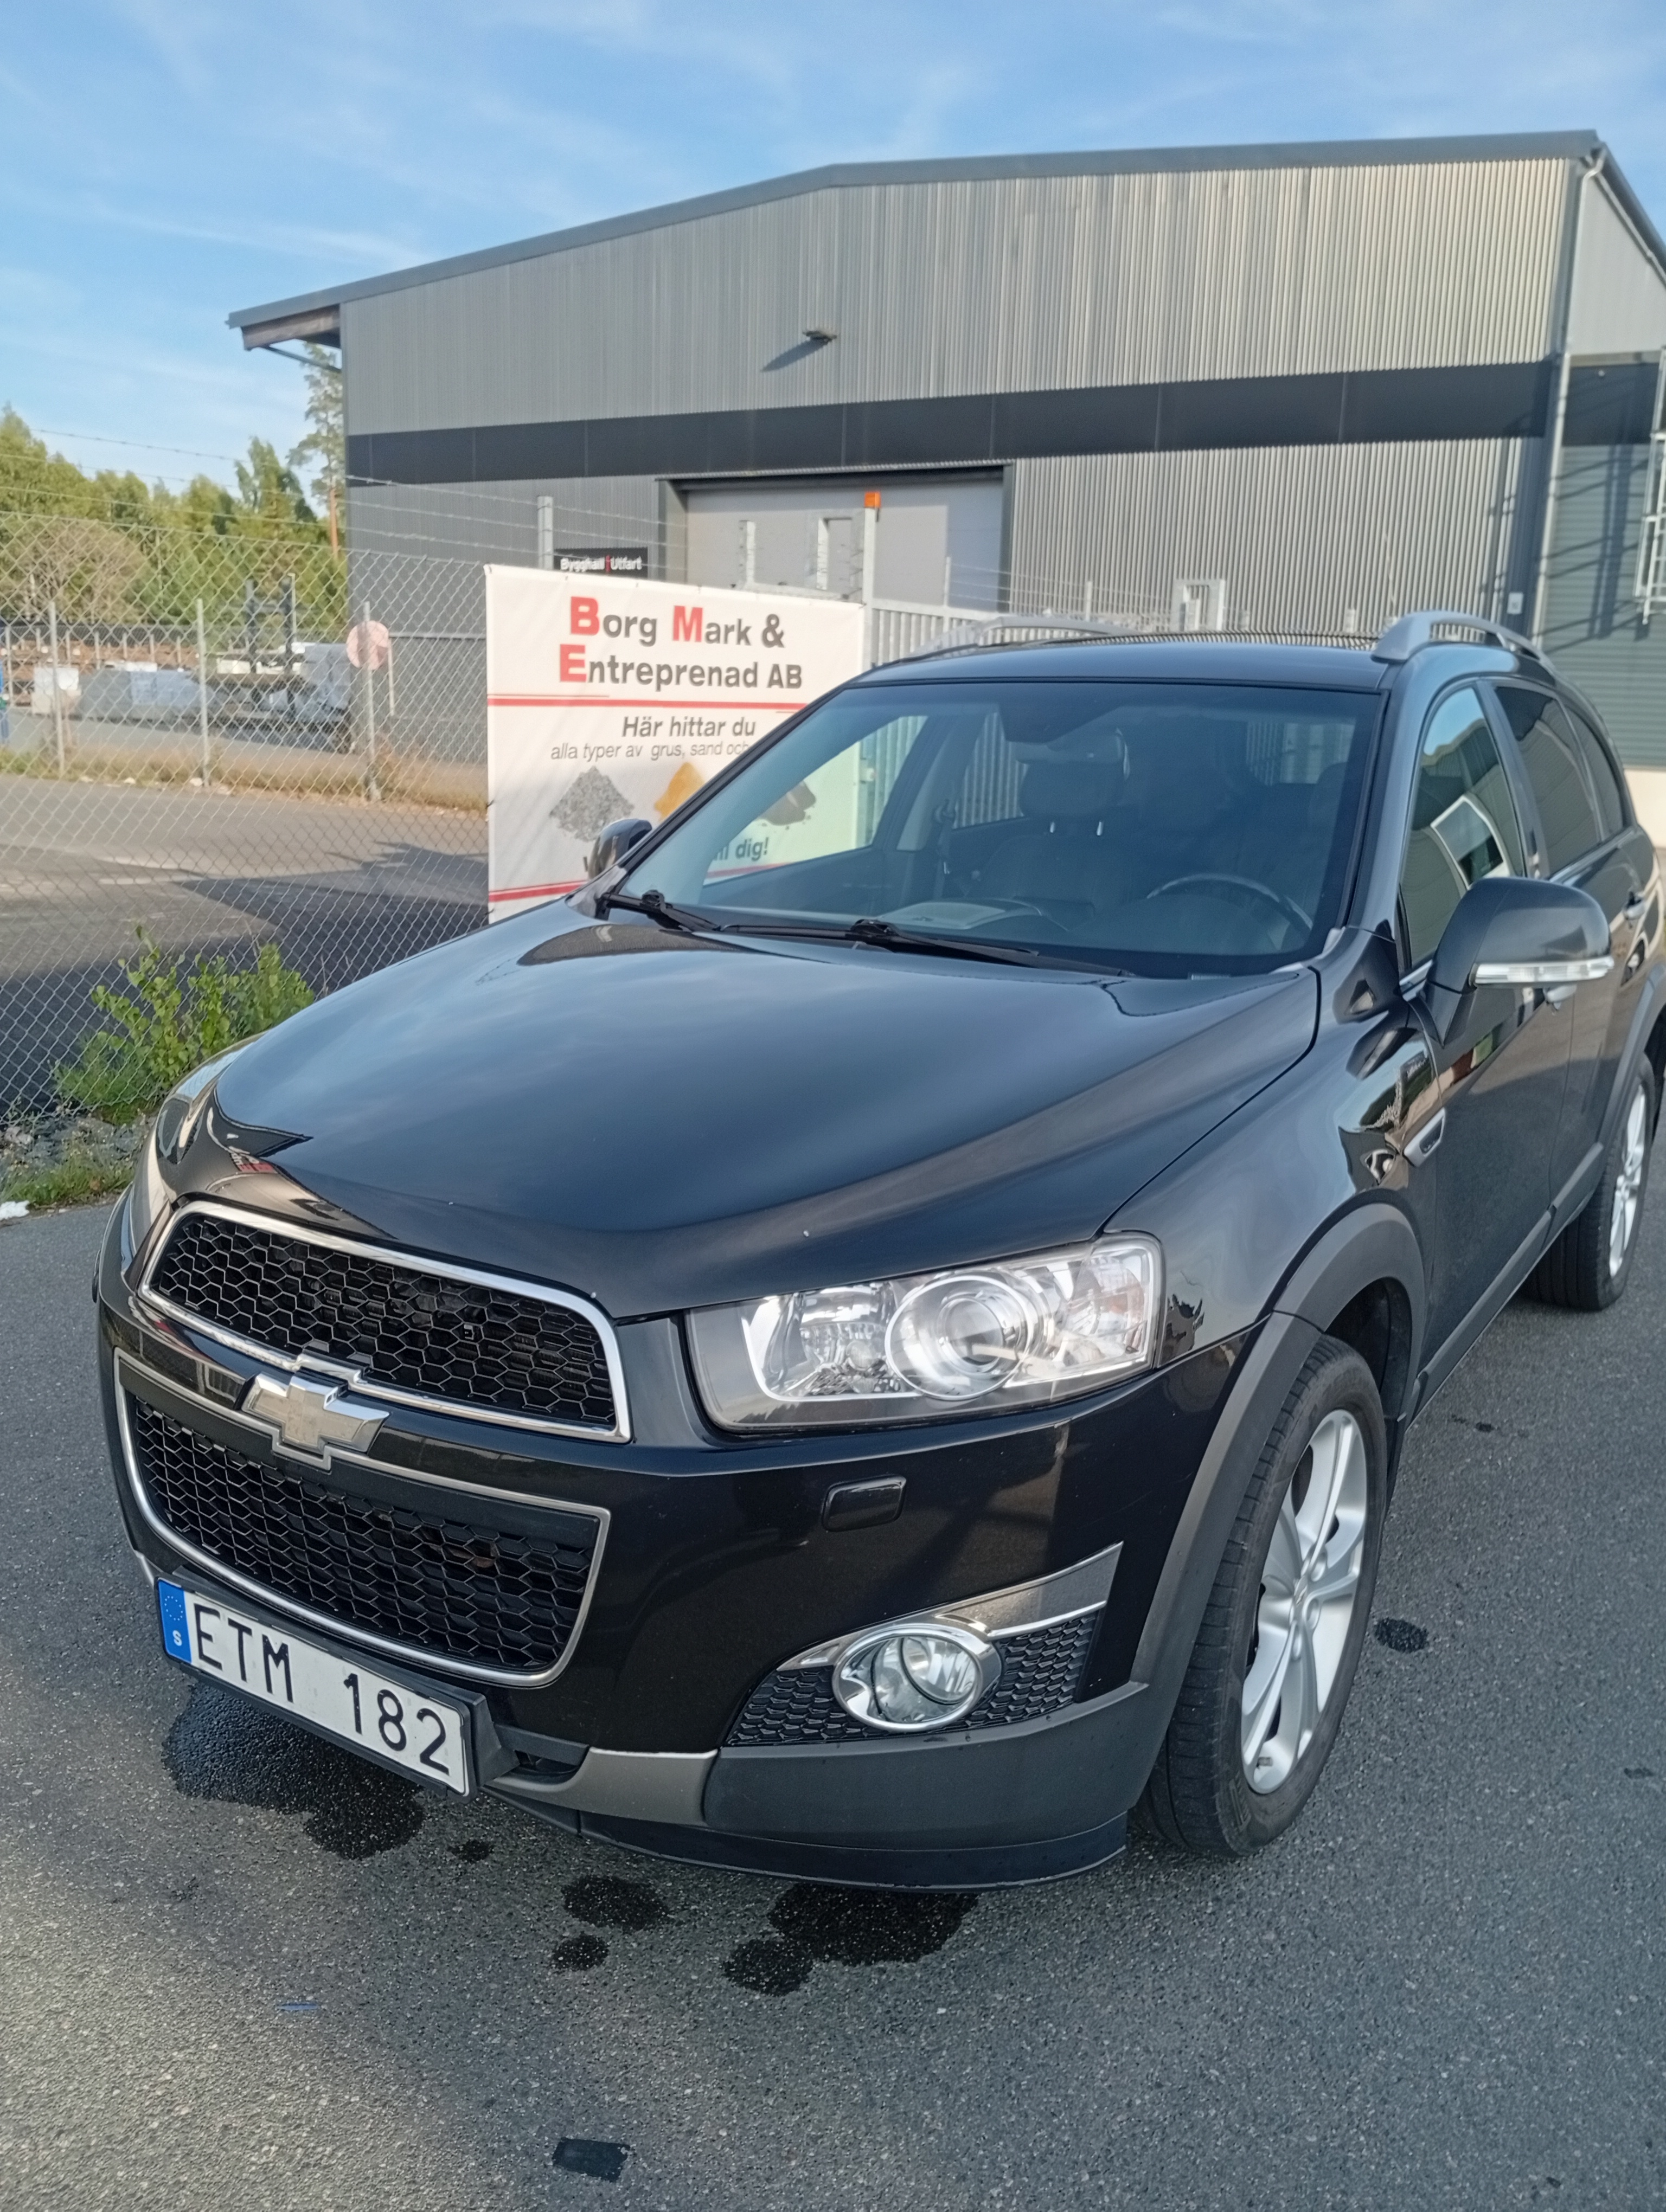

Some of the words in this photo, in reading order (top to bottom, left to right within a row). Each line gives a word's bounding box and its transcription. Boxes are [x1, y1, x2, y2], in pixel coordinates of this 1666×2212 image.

[570, 596, 657, 647] Borg
[672, 606, 752, 646] Mark
[761, 614, 785, 648] &
[560, 644, 758, 692] Entreprenad
[766, 664, 802, 689] AB
[621, 716, 663, 737] Här
[669, 716, 727, 737] hittar
[732, 717, 756, 737] du
[551, 743, 578, 760] alla
[584, 743, 621, 762] typer
[626, 745, 643, 757] av
[651, 744, 685, 761] grus,
[690, 742, 723, 756] sand
[735, 837, 769, 861] dig!
[172, 1630, 182, 1647] S
[194, 1603, 294, 1703] ETM
[343, 1673, 450, 1776] 182
